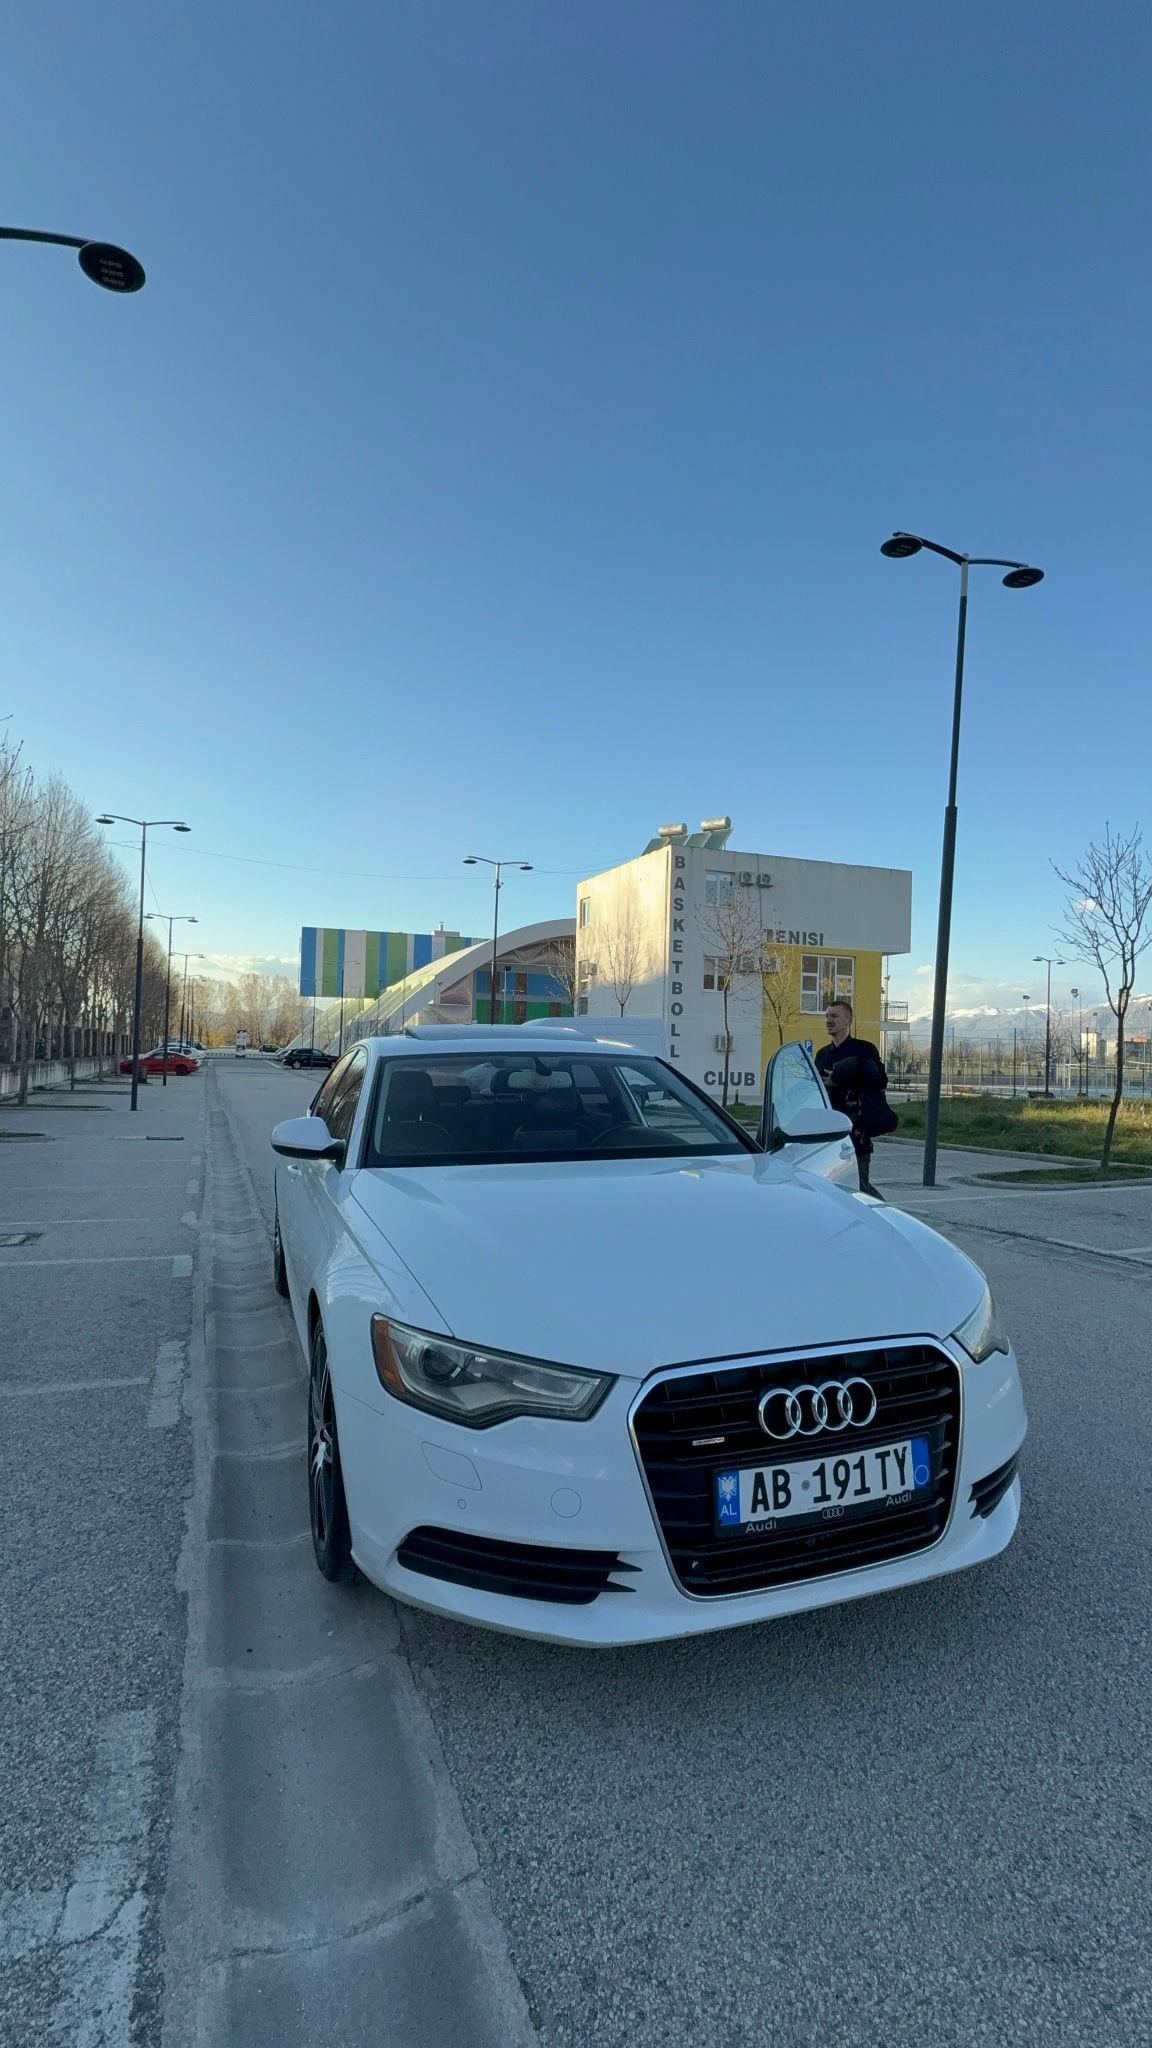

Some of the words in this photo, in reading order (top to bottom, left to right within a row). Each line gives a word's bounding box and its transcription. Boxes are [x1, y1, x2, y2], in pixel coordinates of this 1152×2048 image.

[763, 928, 824, 947] TENISI
[670, 855, 686, 1058] BASKETBOLL
[704, 1070, 755, 1087] CLUB
[751, 1469, 792, 1513] AB
[812, 1456, 871, 1504] 191
[876, 1446, 908, 1491] TY
[886, 1492, 912, 1507] Audi
[720, 1506, 737, 1517] AL
[745, 1519, 777, 1534] Audi
